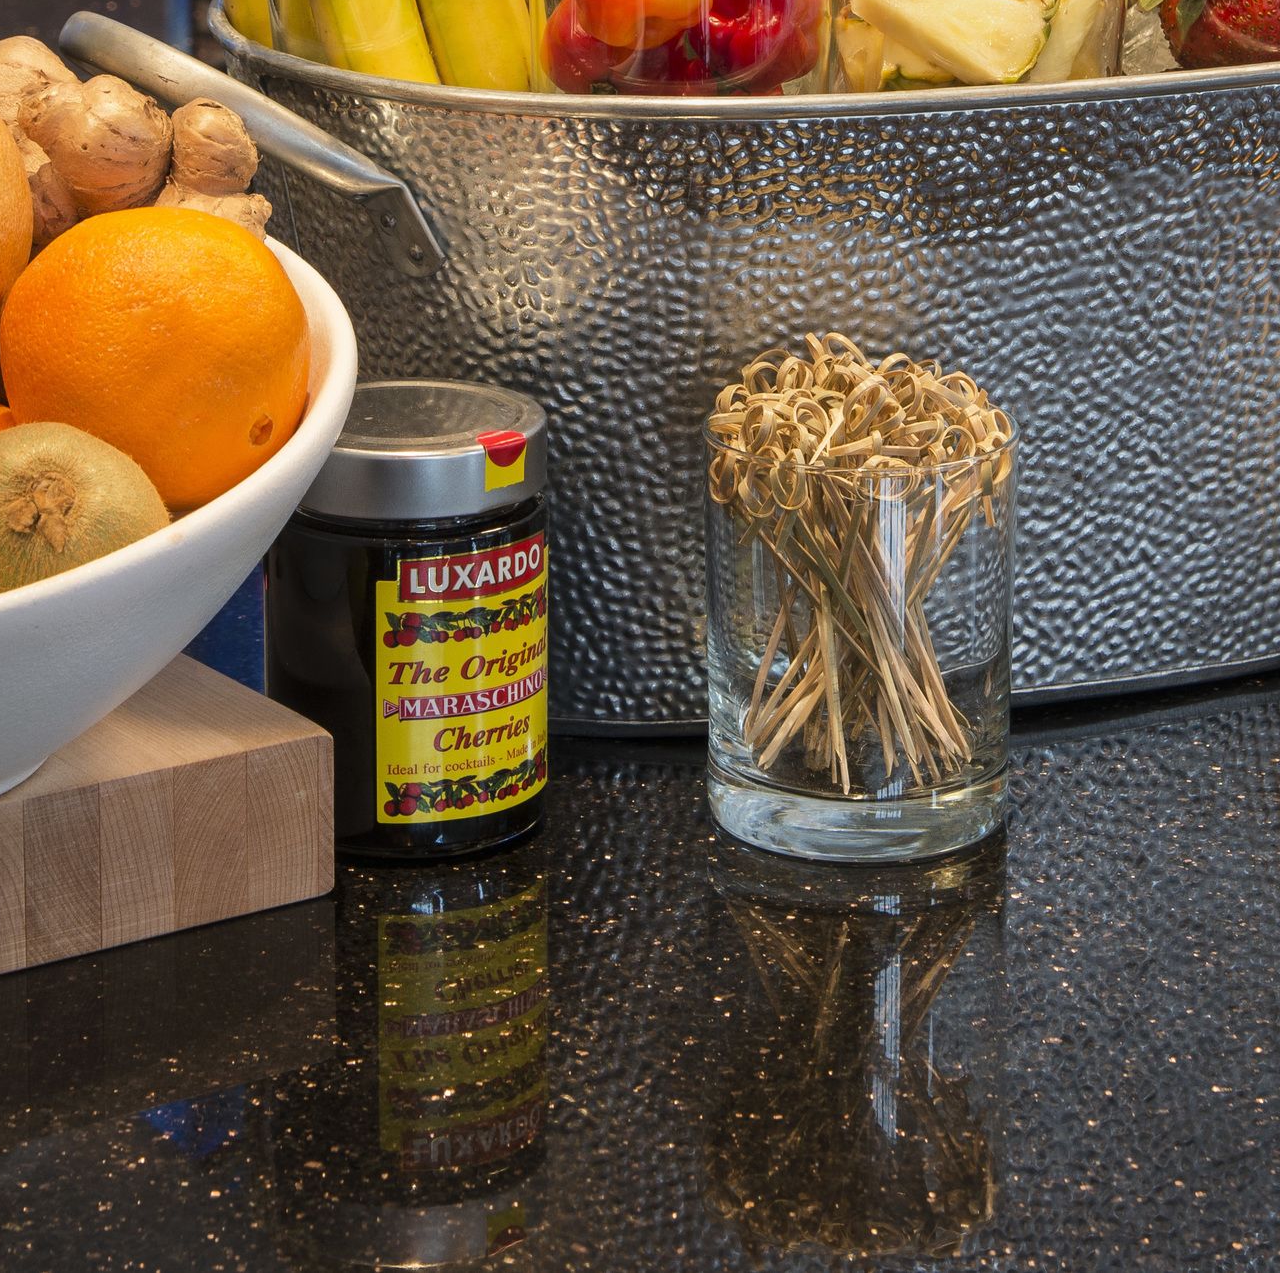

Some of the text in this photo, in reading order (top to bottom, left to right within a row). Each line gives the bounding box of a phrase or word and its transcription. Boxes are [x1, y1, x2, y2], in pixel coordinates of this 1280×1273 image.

[410, 543, 541, 594] LUXARDO
[388, 626, 547, 685] The Original
[401, 671, 542, 719] MARASCHINO
[433, 715, 531, 752] Cherries
[387, 763, 418, 776] Ideal
[423, 762, 441, 774] for
[445, 754, 496, 773] cocktails
[507, 743, 529, 761] Made
